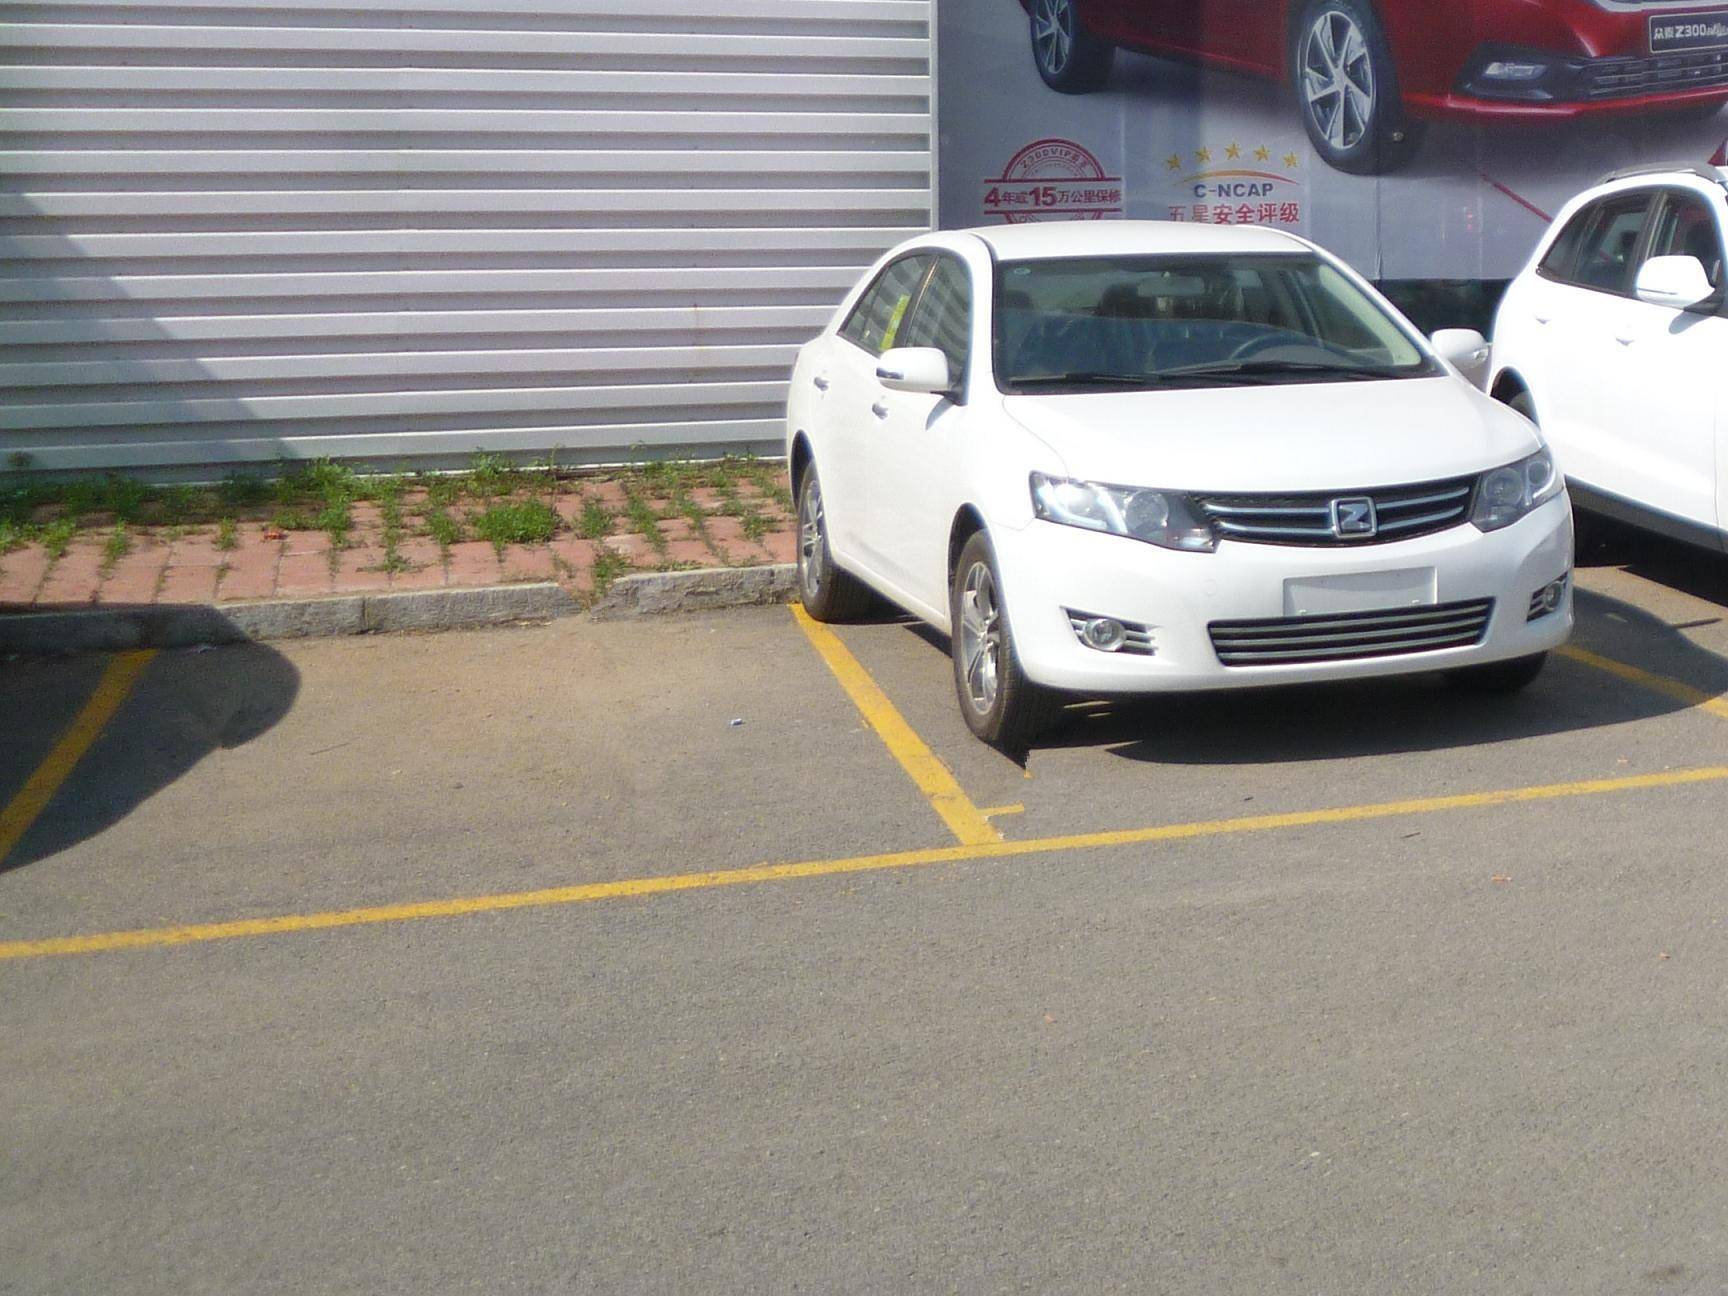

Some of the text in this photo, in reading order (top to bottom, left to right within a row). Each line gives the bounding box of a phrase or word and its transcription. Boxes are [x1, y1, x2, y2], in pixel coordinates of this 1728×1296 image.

[984, 187, 1120, 207] 4年或15万公里保修
[1194, 184, 1274, 198] C-NCAP
[1168, 202, 1300, 224] 五星安全评级
